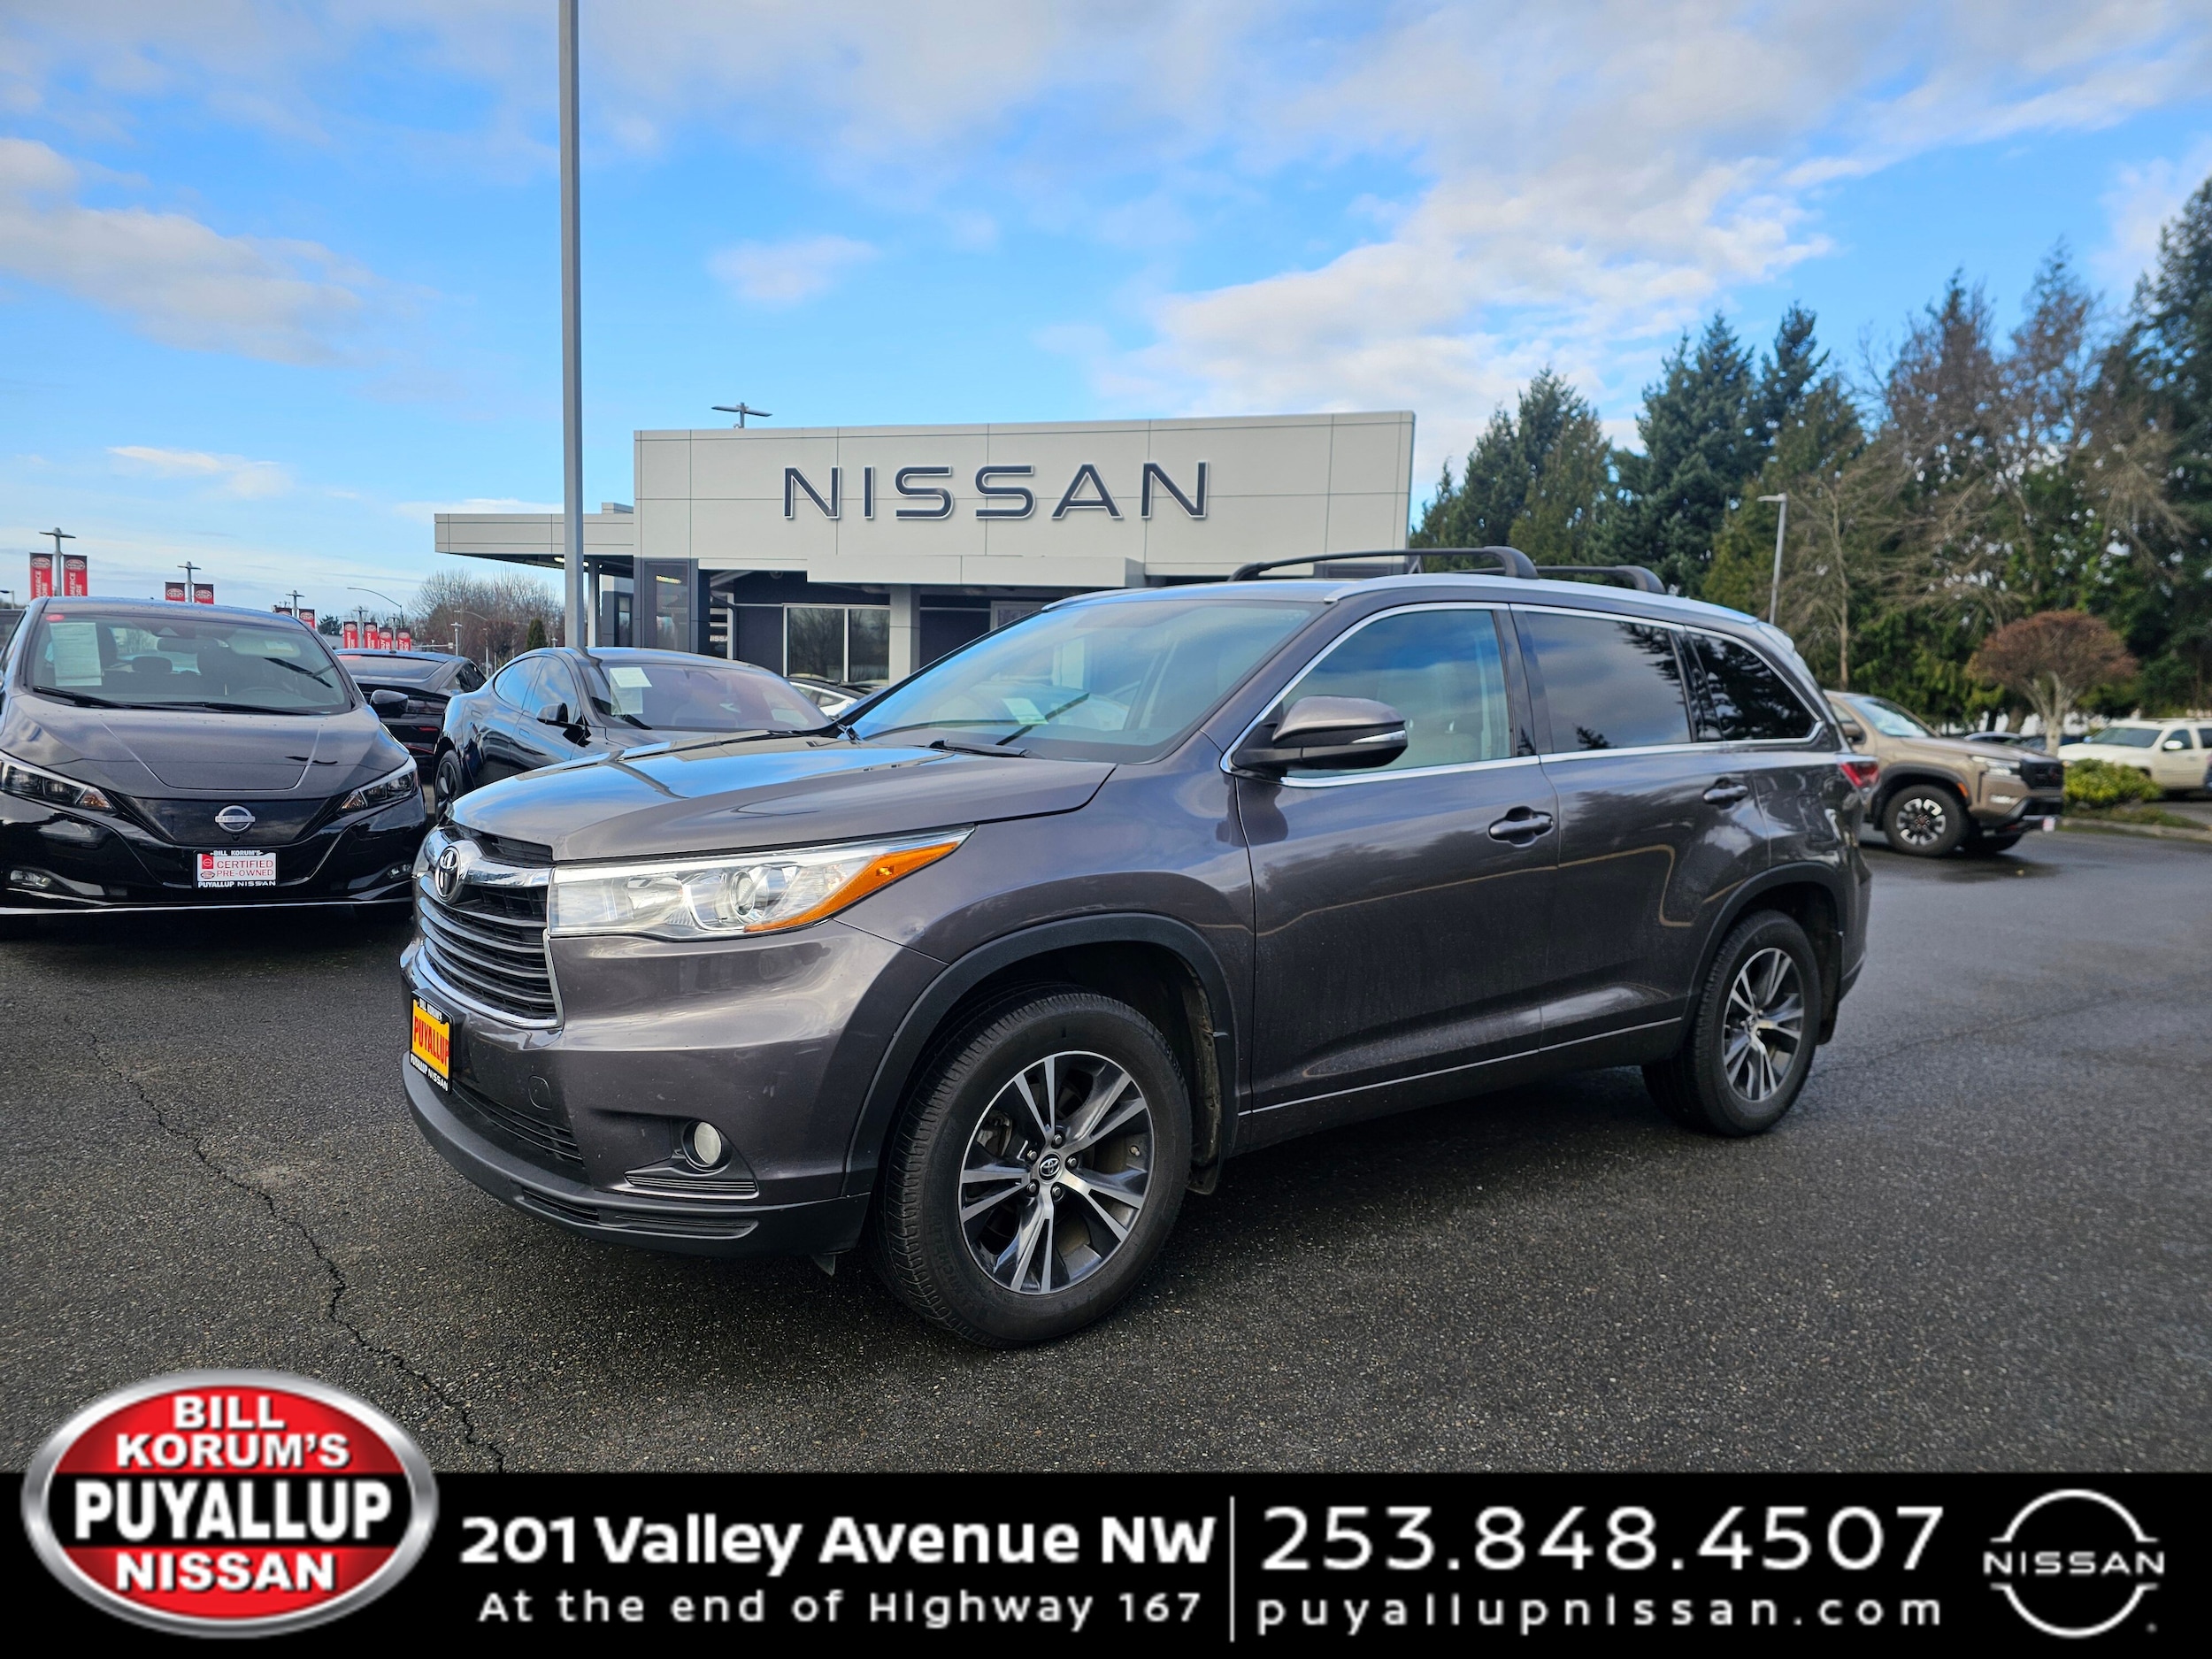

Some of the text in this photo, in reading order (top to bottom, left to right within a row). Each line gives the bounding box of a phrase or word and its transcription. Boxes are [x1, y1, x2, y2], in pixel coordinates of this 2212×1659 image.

[784, 462, 1209, 521] NISSAN
[216, 860, 273, 869] CERTIFIED
[413, 1015, 449, 1067] PUYALLUP
[427, 1068, 449, 1092] NISSAN
